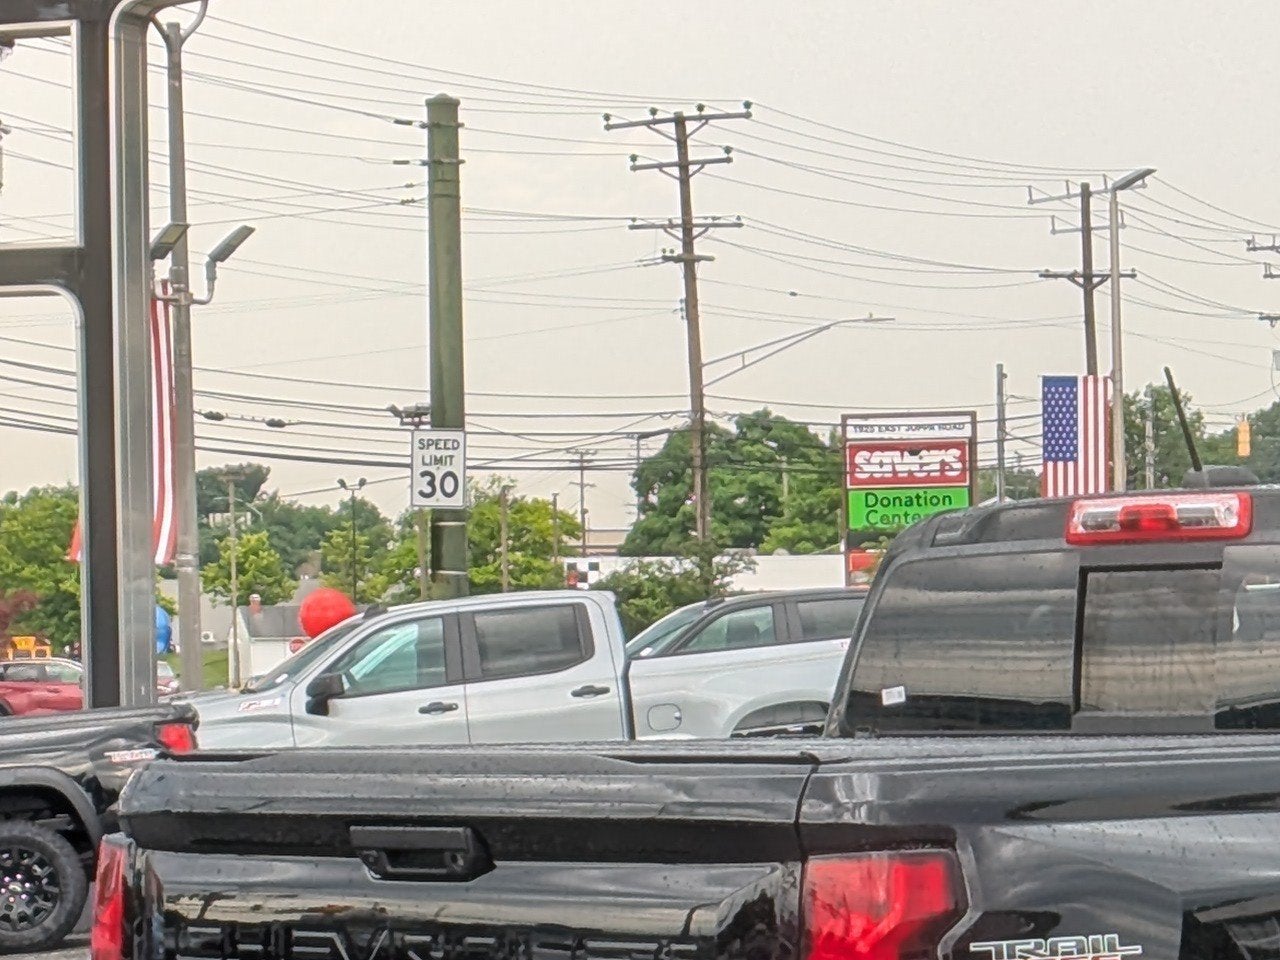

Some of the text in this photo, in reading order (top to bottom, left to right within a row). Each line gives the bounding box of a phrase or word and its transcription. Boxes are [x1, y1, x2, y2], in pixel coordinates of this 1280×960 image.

[418, 438, 460, 450] SPEED
[421, 455, 455, 466] LIMIT
[417, 470, 459, 498] 30
[864, 491, 953, 508] Donation
[865, 509, 924, 525] Cente
[969, 934, 1143, 960] TRAIL
